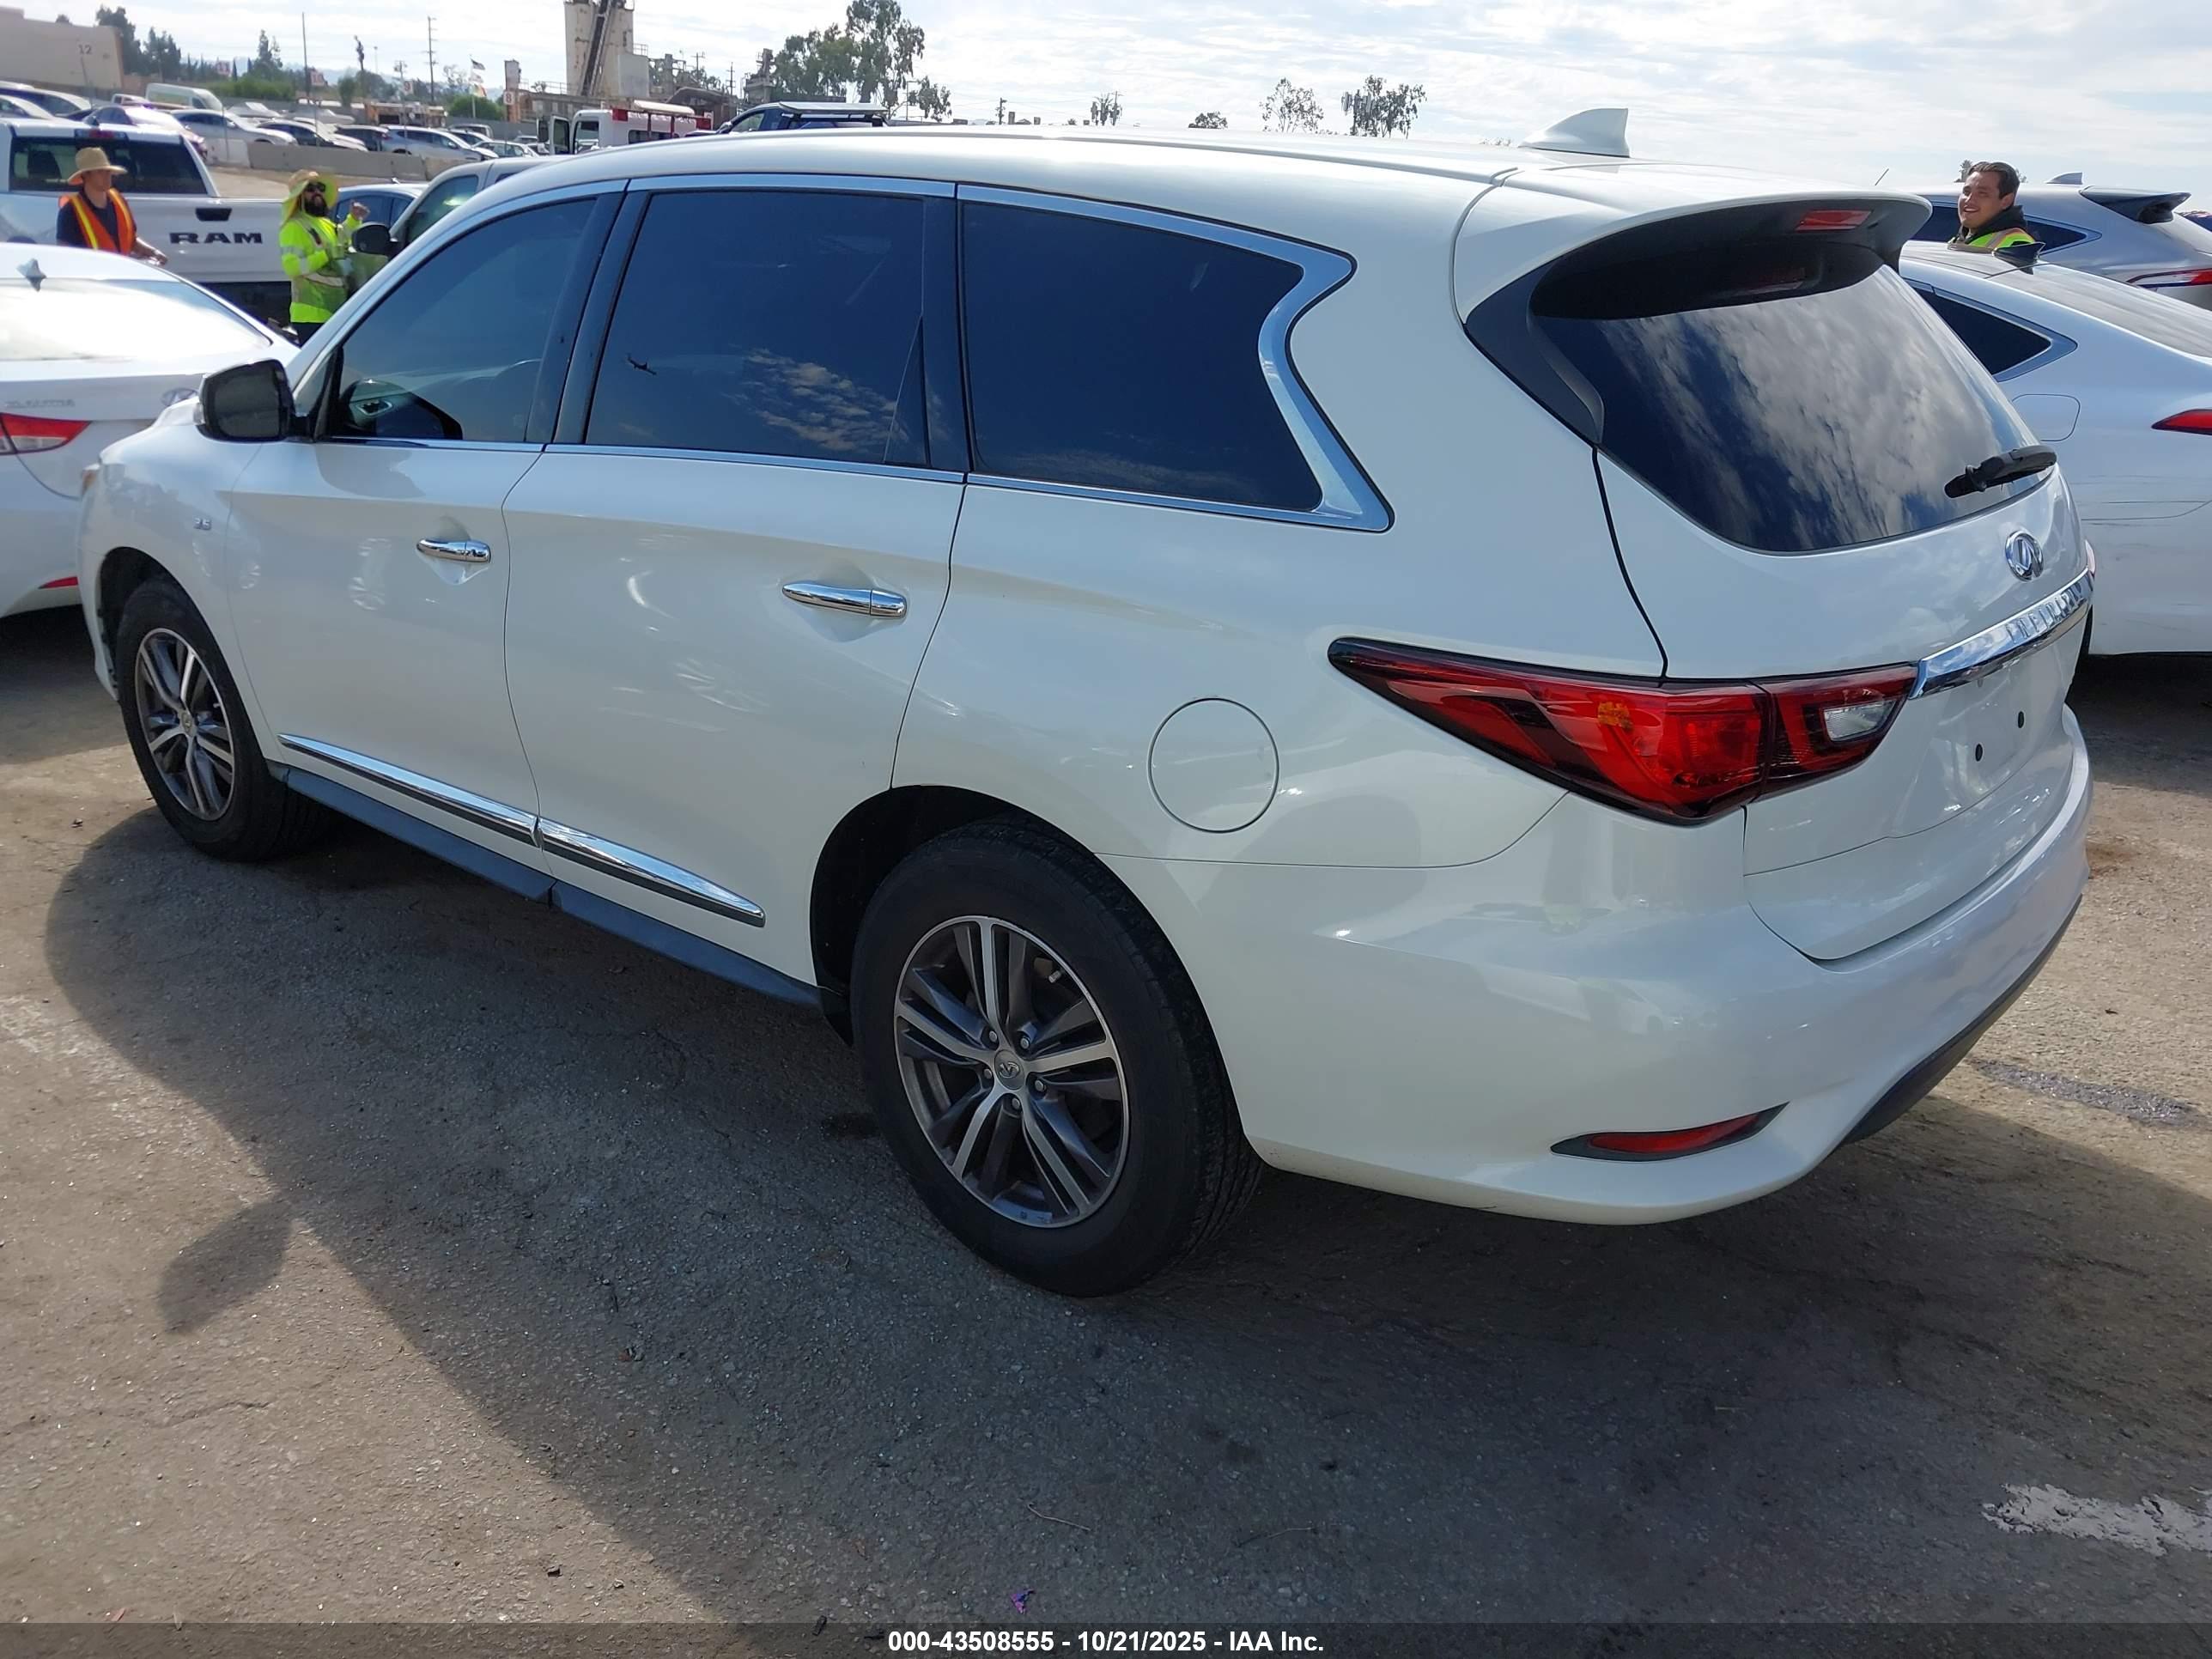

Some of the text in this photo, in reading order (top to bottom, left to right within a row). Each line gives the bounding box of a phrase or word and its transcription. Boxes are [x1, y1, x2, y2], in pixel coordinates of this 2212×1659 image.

[78, 44, 93, 55] 12
[506, 92, 513, 103] 8
[169, 232, 263, 244] RAM
